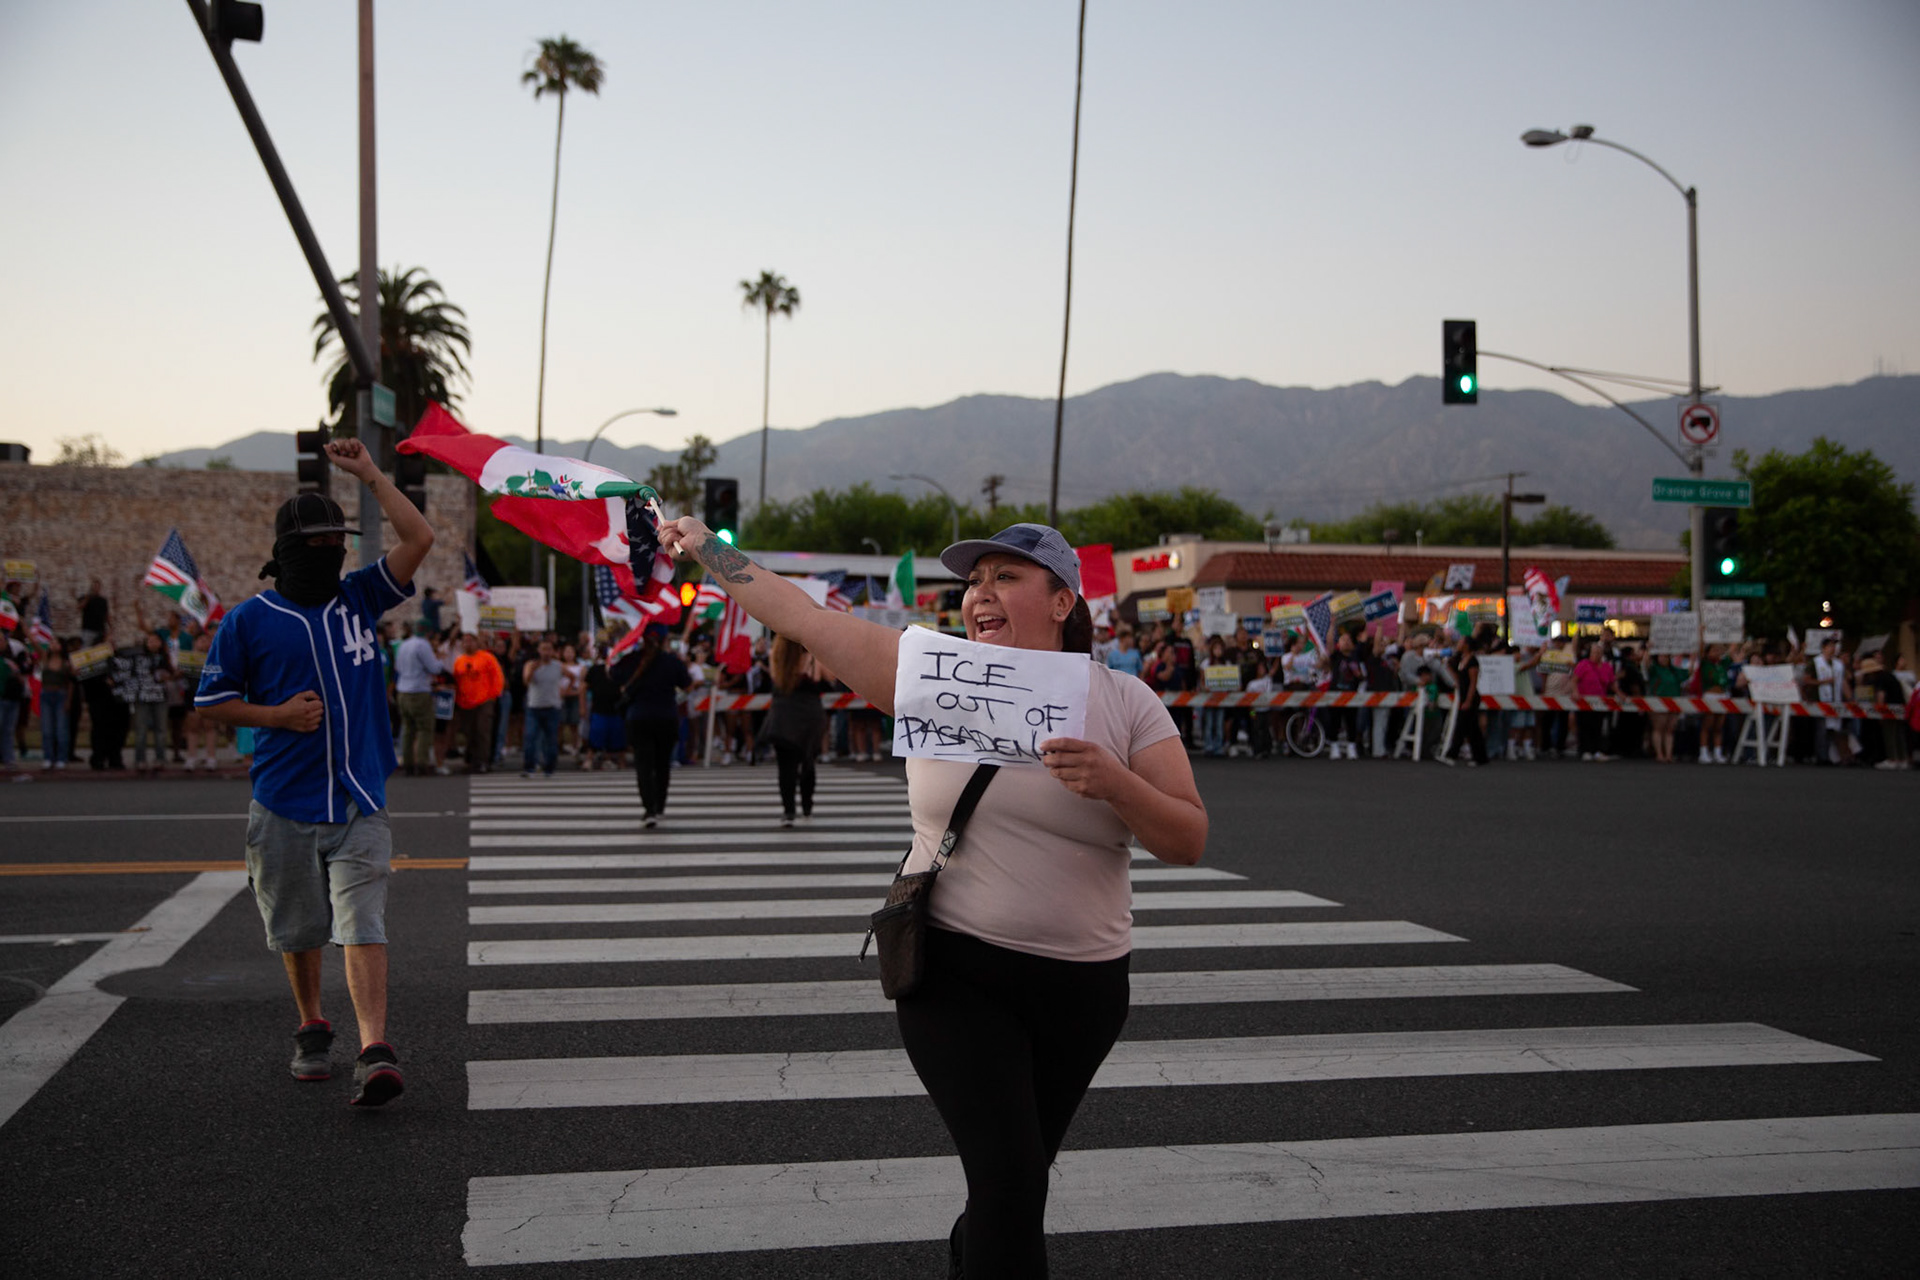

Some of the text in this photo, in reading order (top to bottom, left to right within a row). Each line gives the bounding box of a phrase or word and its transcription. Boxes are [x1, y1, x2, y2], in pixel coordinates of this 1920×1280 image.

[1653, 486, 1693, 498] Orange
[1699, 486, 1731, 499] Grove
[335, 604, 375, 666] LA
[920, 651, 1032, 692] ICE
[936, 692, 1069, 733] OUT OF
[897, 713, 1050, 761] PASADEN
